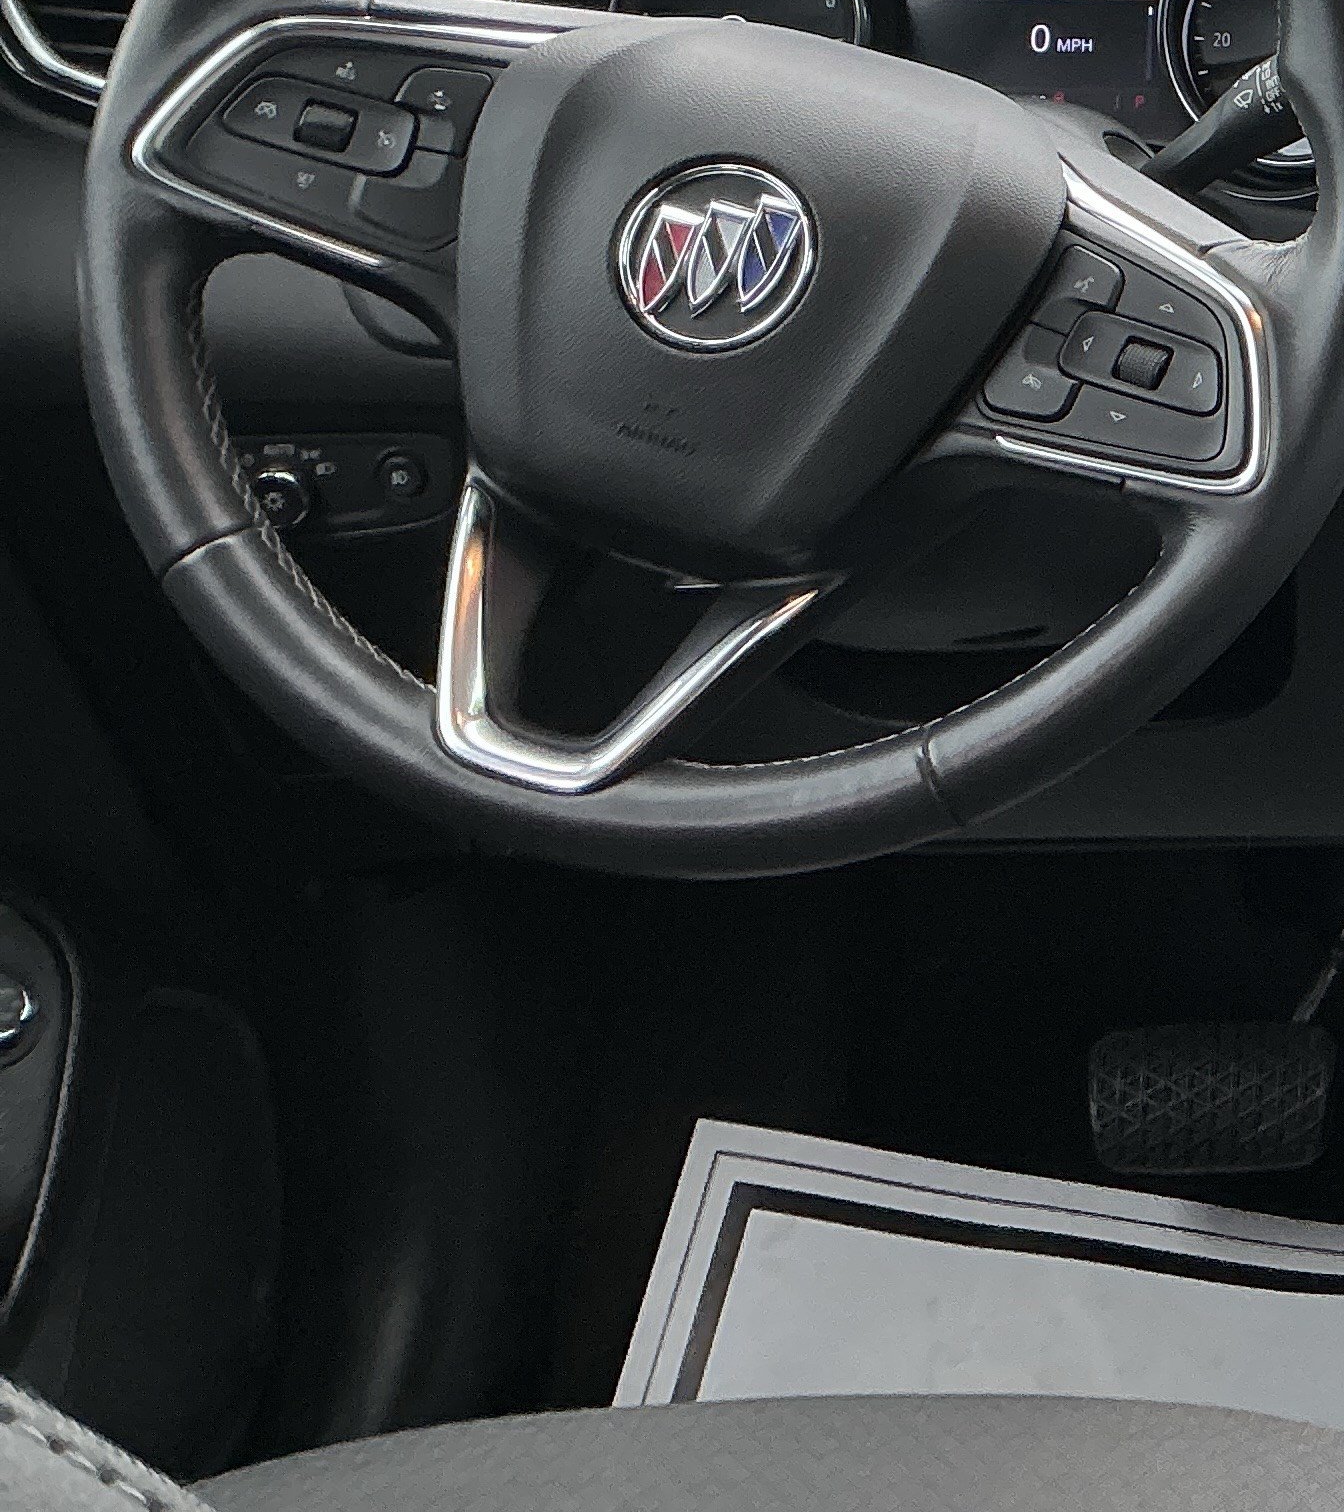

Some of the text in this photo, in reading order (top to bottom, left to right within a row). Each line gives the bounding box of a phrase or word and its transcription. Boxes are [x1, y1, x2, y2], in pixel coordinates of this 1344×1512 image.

[1030, 24, 1093, 54] 0 MPH
[1213, 32, 1231, 48] 20
